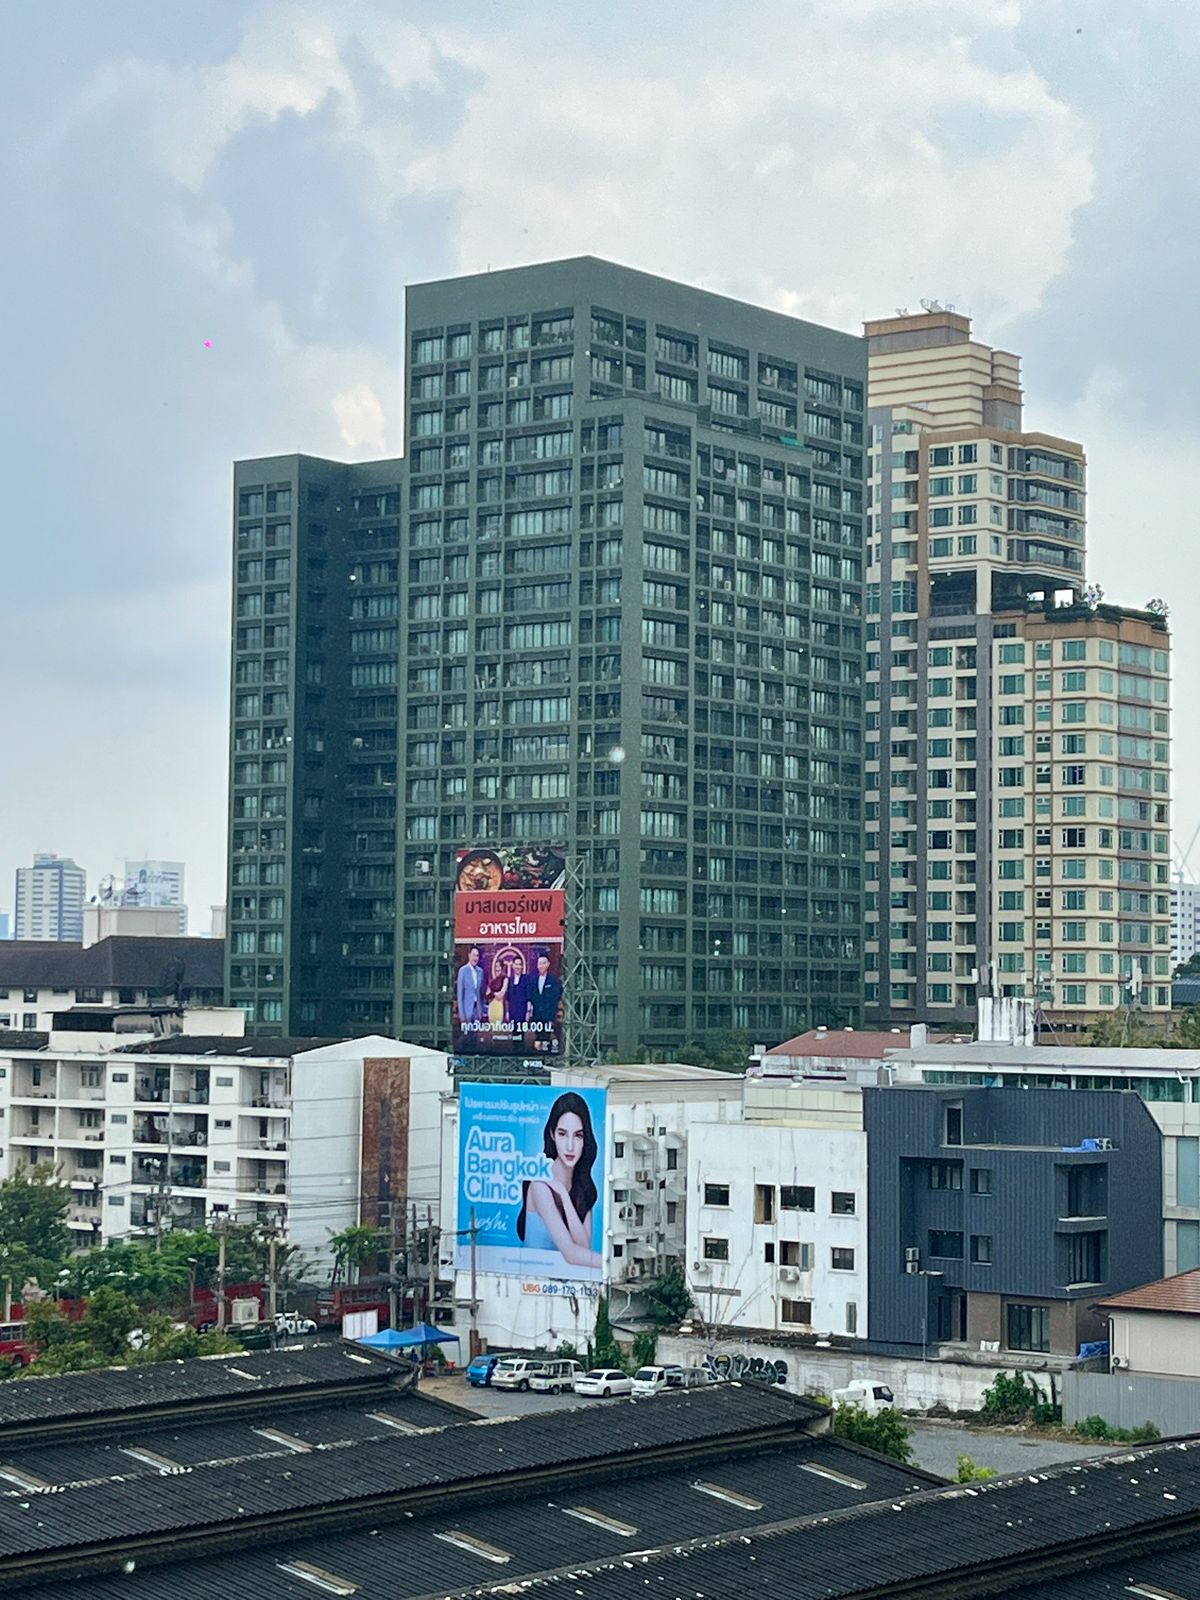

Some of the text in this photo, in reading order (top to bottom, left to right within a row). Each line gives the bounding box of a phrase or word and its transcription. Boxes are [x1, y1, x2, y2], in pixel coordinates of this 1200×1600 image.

[479, 916, 537, 935] อาหารไทย
[516, 1021, 543, 1033] 18.00
[468, 1129, 512, 1153] Aura
[467, 1152, 550, 1182] Bangkok
[466, 1175, 519, 1201] Clinic
